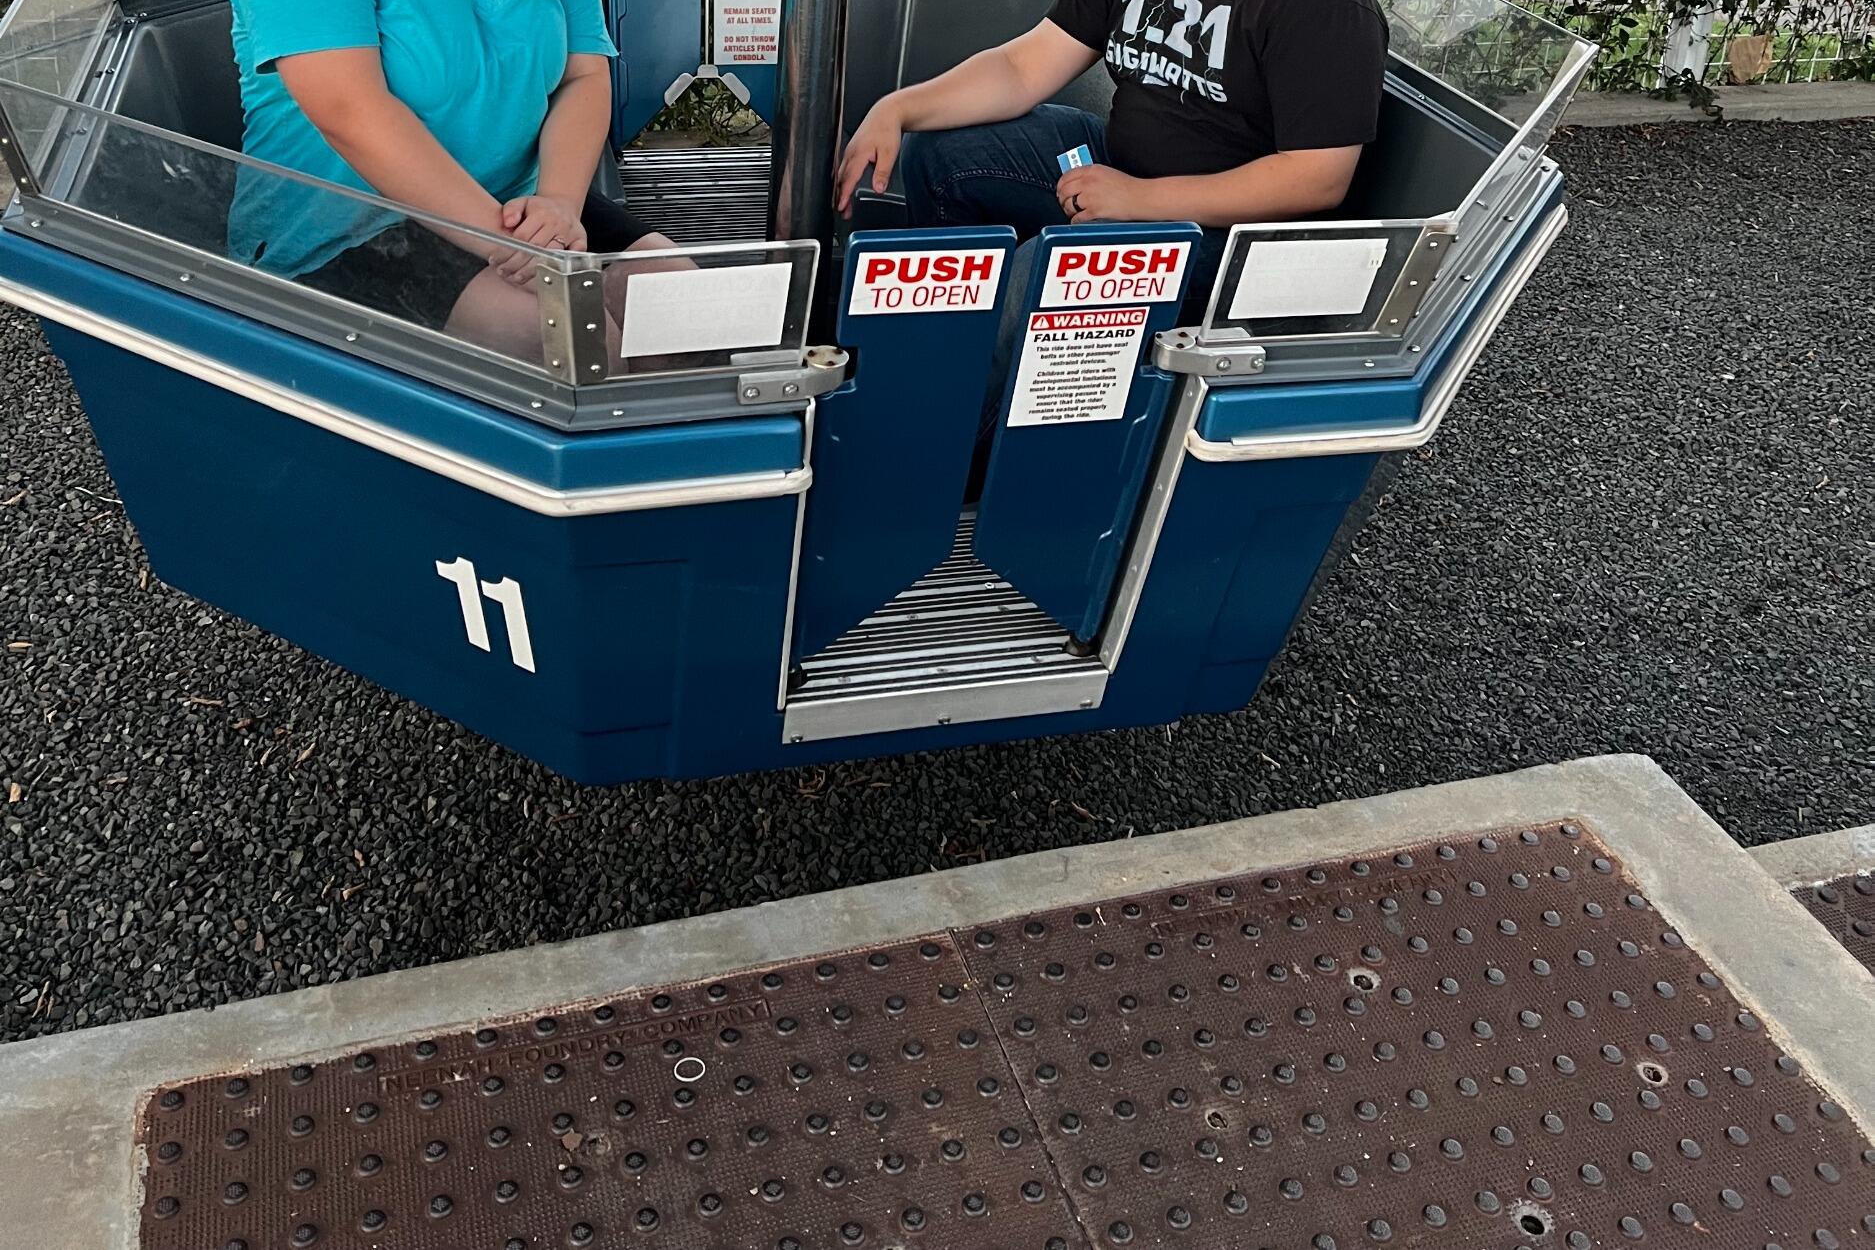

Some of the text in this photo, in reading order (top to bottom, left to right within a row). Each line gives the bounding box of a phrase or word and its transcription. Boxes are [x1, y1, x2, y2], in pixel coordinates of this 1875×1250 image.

[727, 16, 734, 24] AT
[752, 7, 776, 15] SEATED
[1105, 39, 1228, 102] GIGIWATTS
[865, 255, 993, 284] PUSH
[1056, 248, 1179, 277] PUSH
[871, 285, 980, 308] TO OPEN
[1062, 277, 1165, 300] TO OPEN
[1053, 312, 1143, 328] WARNING
[1034, 329, 1136, 342] FALL HAZARD
[435, 556, 536, 673] 11
[642, 1001, 760, 1039] COMPANY
